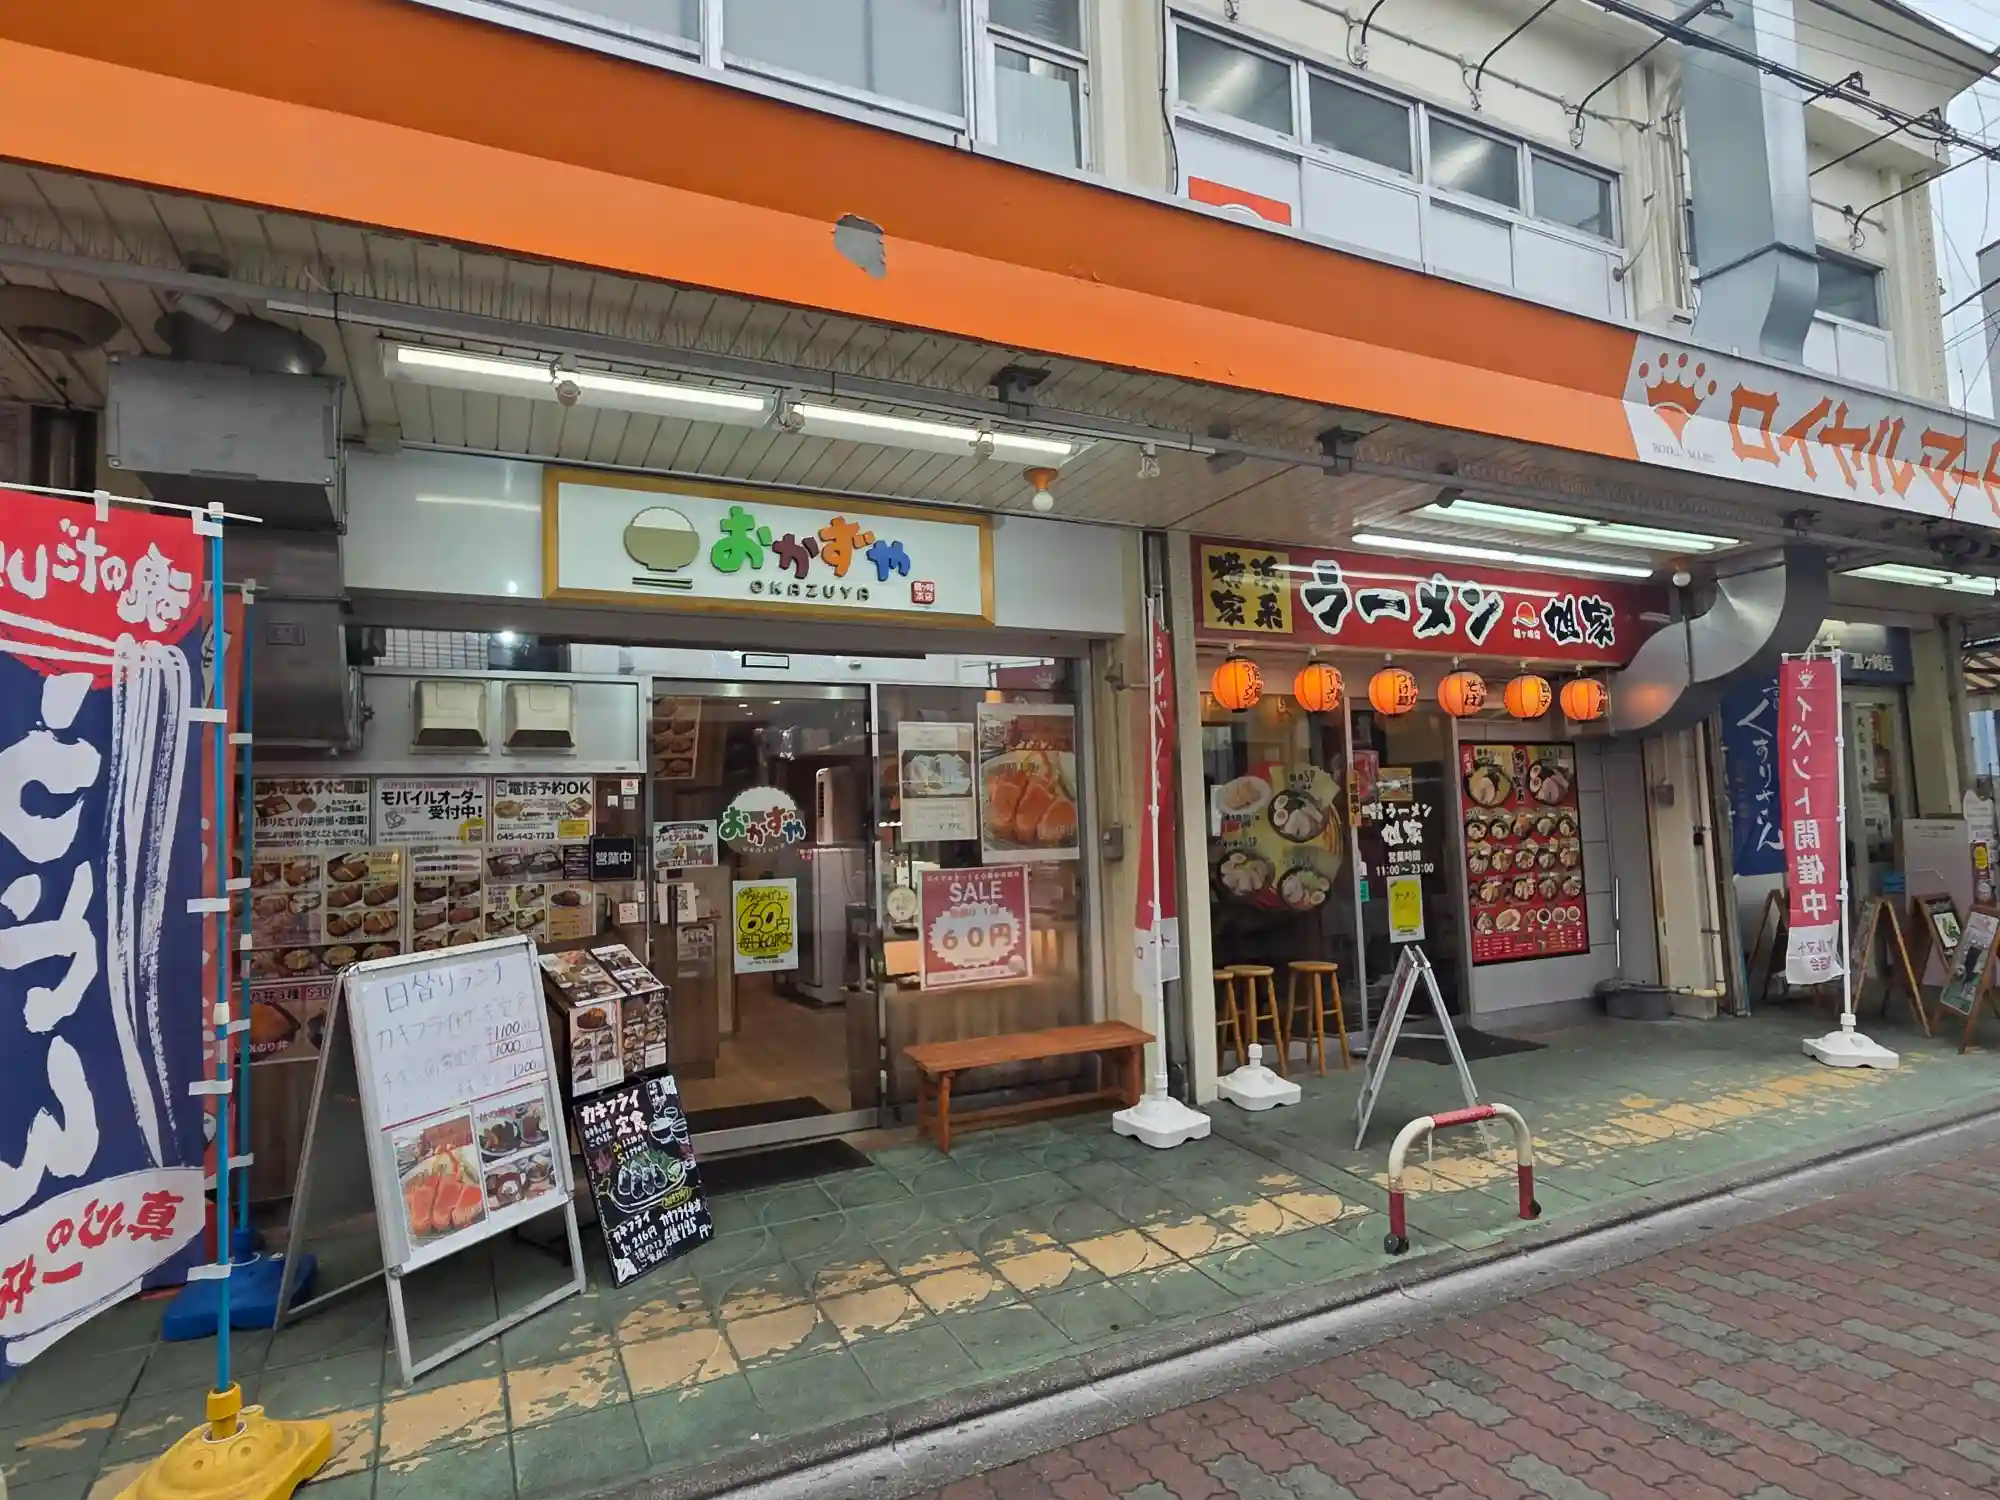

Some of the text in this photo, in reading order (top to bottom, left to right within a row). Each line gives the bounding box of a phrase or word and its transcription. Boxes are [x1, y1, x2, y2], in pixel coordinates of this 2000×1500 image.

[711, 505, 911, 582] おかずや
[749, 579, 870, 602] OKAZUYA
[1300, 559, 1504, 647] ラーメン
[380, 787, 484, 806] モバイルオーダー
[507, 780, 592, 797] 電話予約OK
[427, 804, 483, 820] 受付中!
[718, 805, 807, 846] おかずや
[595, 850, 633, 867] 営業中
[1387, 849, 1422, 864] 営業時間
[948, 880, 1004, 904] SALE
[580, 1089, 640, 1125] カキフライ
[615, 1110, 649, 1138] 定食
[612, 1210, 652, 1244] カキフライ
